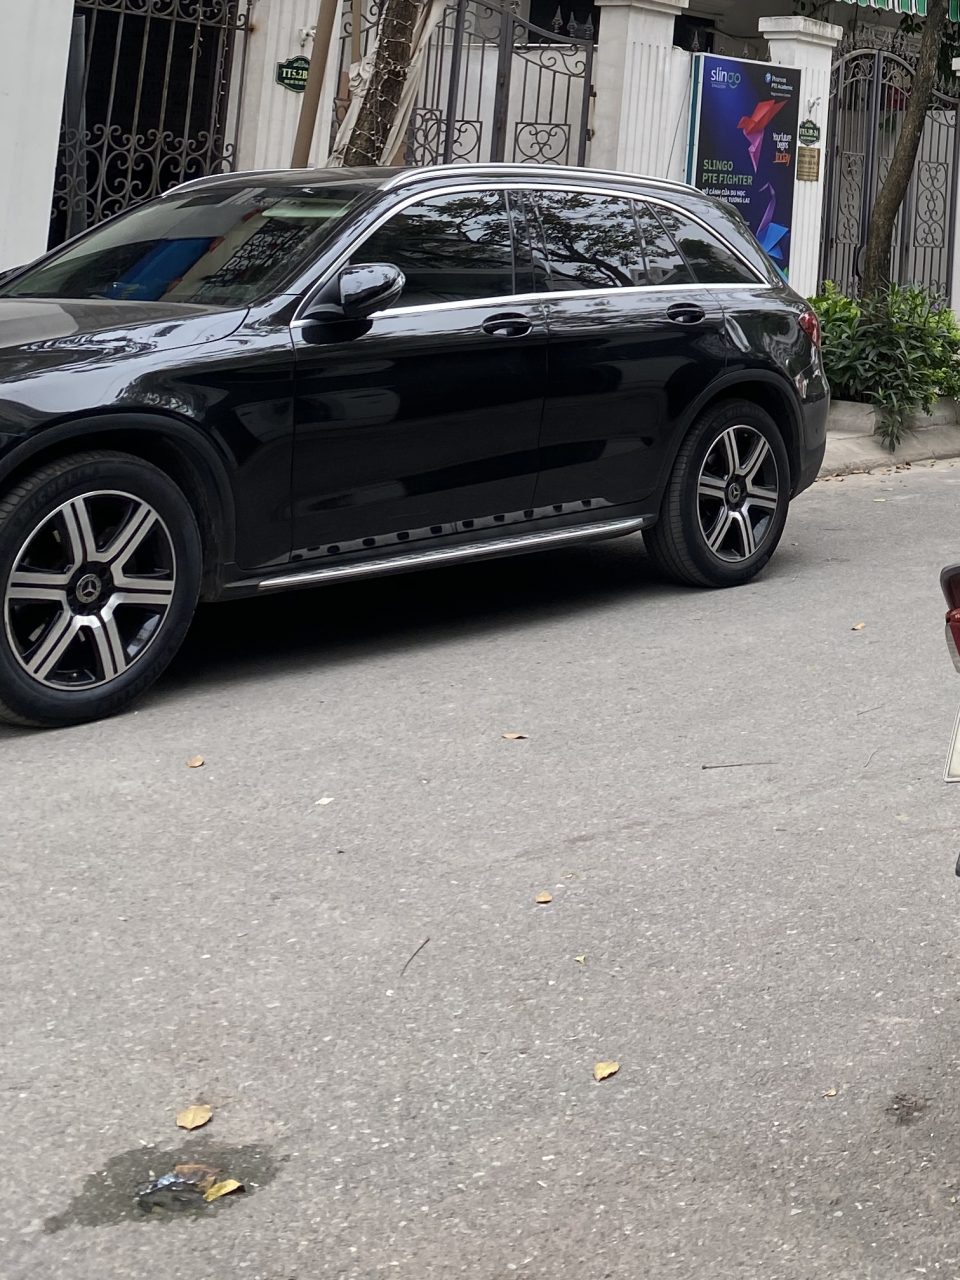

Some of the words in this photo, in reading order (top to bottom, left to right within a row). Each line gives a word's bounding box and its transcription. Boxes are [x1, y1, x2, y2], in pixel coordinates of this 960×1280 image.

[710, 66, 741, 89] slingo
[703, 159, 733, 171] SLINGO
[702, 173, 717, 184] PTE
[719, 173, 753, 186] FIGHTER
